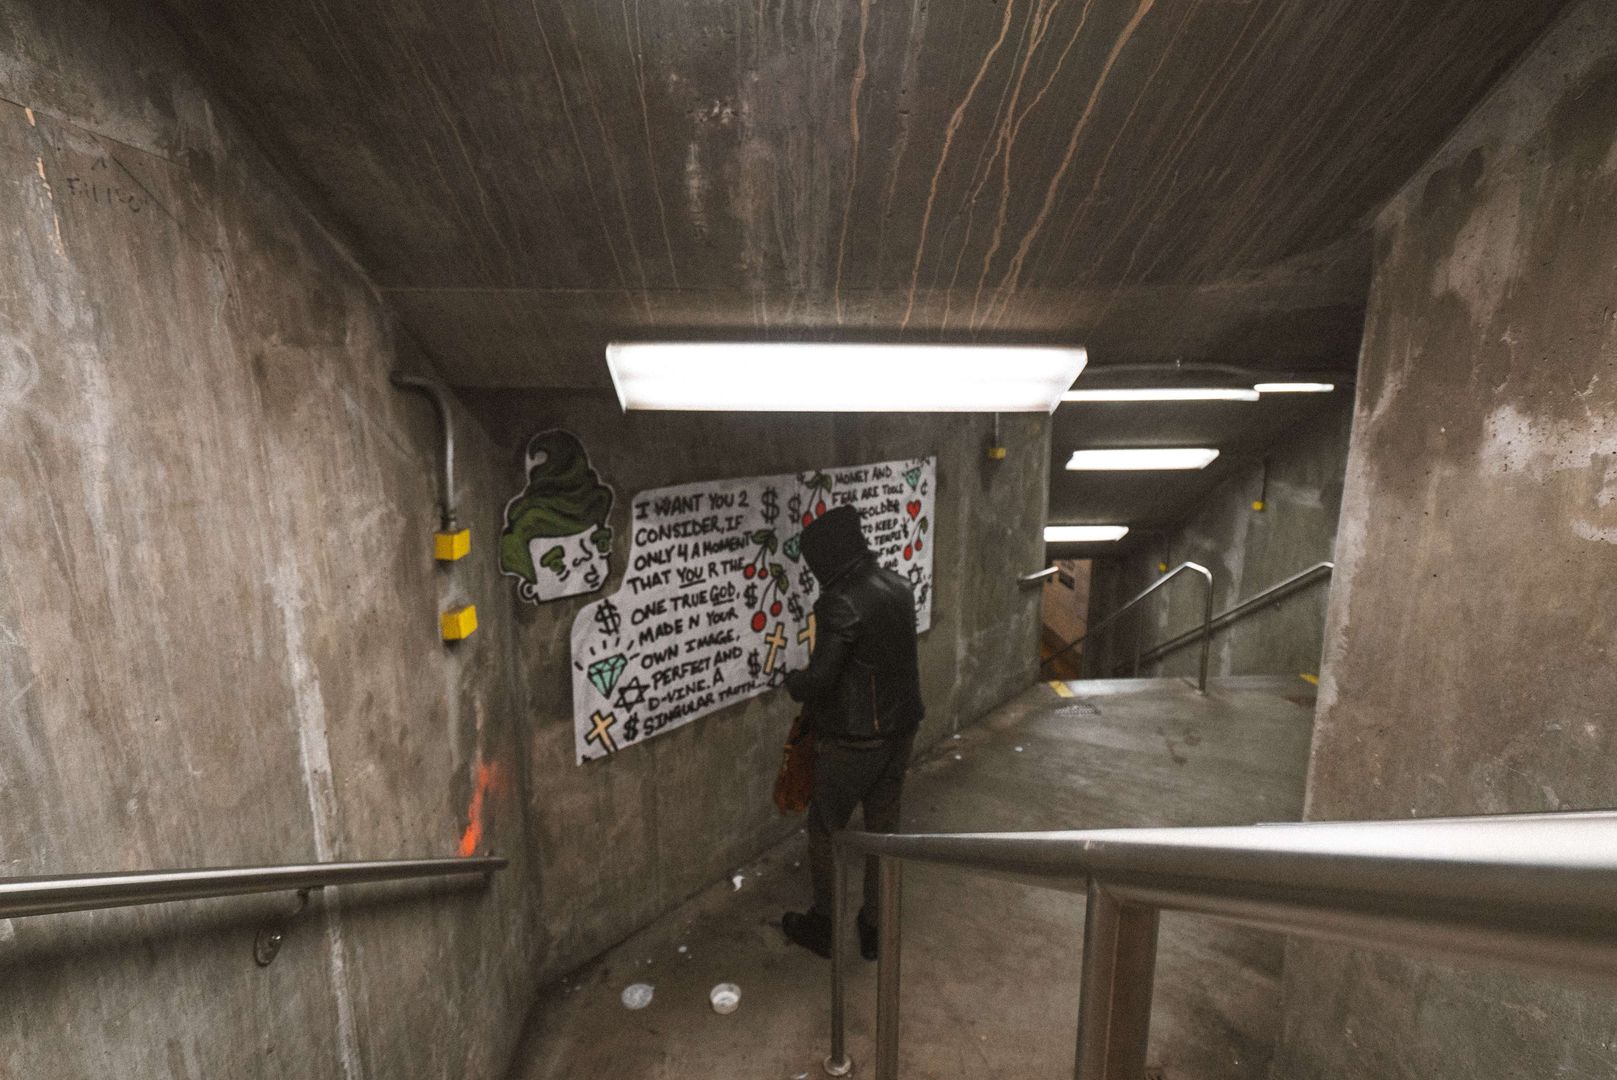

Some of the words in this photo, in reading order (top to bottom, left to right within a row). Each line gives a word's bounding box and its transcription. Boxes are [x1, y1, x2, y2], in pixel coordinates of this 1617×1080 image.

[834, 469, 869, 486] MONEY
[872, 465, 892, 481] AND
[861, 486, 879, 501] ARE
[635, 501, 650, 520] I
[655, 493, 703, 516] WANT
[708, 492, 735, 510] YOU
[738, 490, 749, 507] 2
[875, 518, 898, 532] KEEP
[634, 545, 675, 571] ONLY
[677, 543, 688, 562] 4
[691, 542, 700, 559] A
[703, 531, 752, 556] MOMENT
[635, 515, 724, 547] CONSIDER,
[725, 515, 744, 532] IF
[626, 569, 671, 595] THAT
[676, 566, 705, 585] YOU
[708, 562, 719, 578] R
[720, 557, 745, 575] THE
[631, 598, 667, 626] ONE
[669, 590, 708, 612] TRUE
[709, 581, 740, 604] GOD,
[639, 618, 683, 647] MADE
[688, 614, 700, 630] N
[706, 606, 739, 627] YOUR
[640, 644, 679, 670] OWN
[684, 628, 740, 653] IMAGE,
[651, 657, 711, 690] PERFECT
[714, 646, 743, 667] AND
[648, 679, 711, 711] D-VINE.
[713, 667, 724, 686] A
[643, 692, 715, 736] SINGULAR
